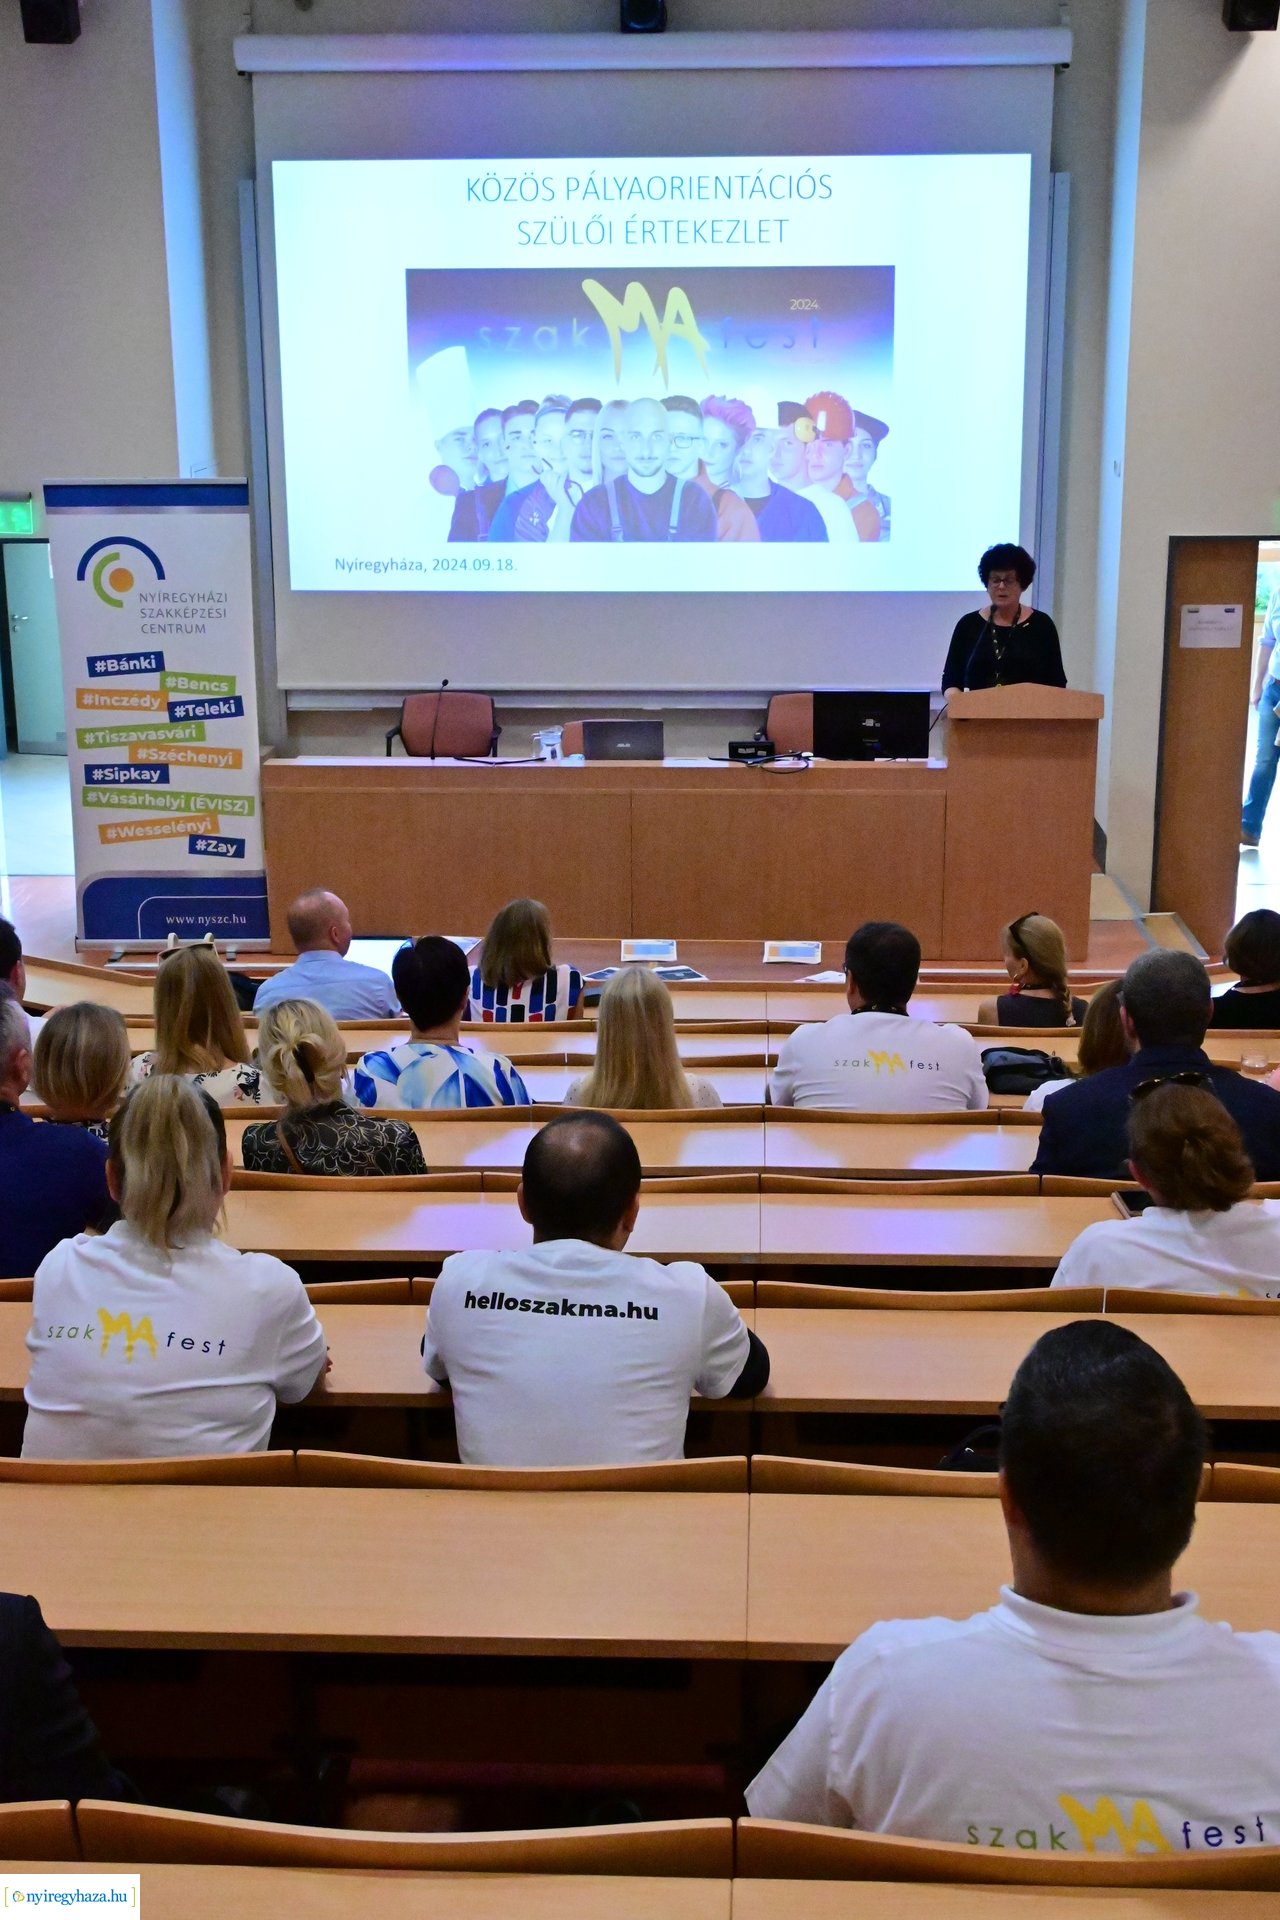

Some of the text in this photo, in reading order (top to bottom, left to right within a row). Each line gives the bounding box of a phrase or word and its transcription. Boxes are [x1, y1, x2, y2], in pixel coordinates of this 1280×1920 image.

[467, 168, 833, 202] KÖZÖS PÁLYAORIENTÁCIÓS
[517, 213, 790, 246] SZÜLŐI ÉRTEKEZLET
[335, 557, 518, 574] Nyíregyháza, 2024.09.18.
[139, 590, 228, 603] NYÍREGYHÁZI
[140, 606, 227, 618] SZAKKÉPZÉSI
[141, 623, 206, 634] CENTRUM
[95, 654, 156, 673] #Bánki
[165, 676, 229, 692] #Bencs
[83, 693, 161, 710] #Inczédy
[174, 699, 236, 718] #Teleki
[84, 725, 197, 745] #Tiszavasvári
[136, 748, 233, 767] #Széchenyi
[92, 767, 161, 782] #Sipkay
[86, 791, 249, 813] #Vásárhelyi (ÉVISZ)
[106, 817, 212, 839] #Wesselényi
[195, 839, 237, 856] #Zay
[165, 914, 247, 926] www.nyszc.hu
[464, 1291, 658, 1320] helloszakma.hu
